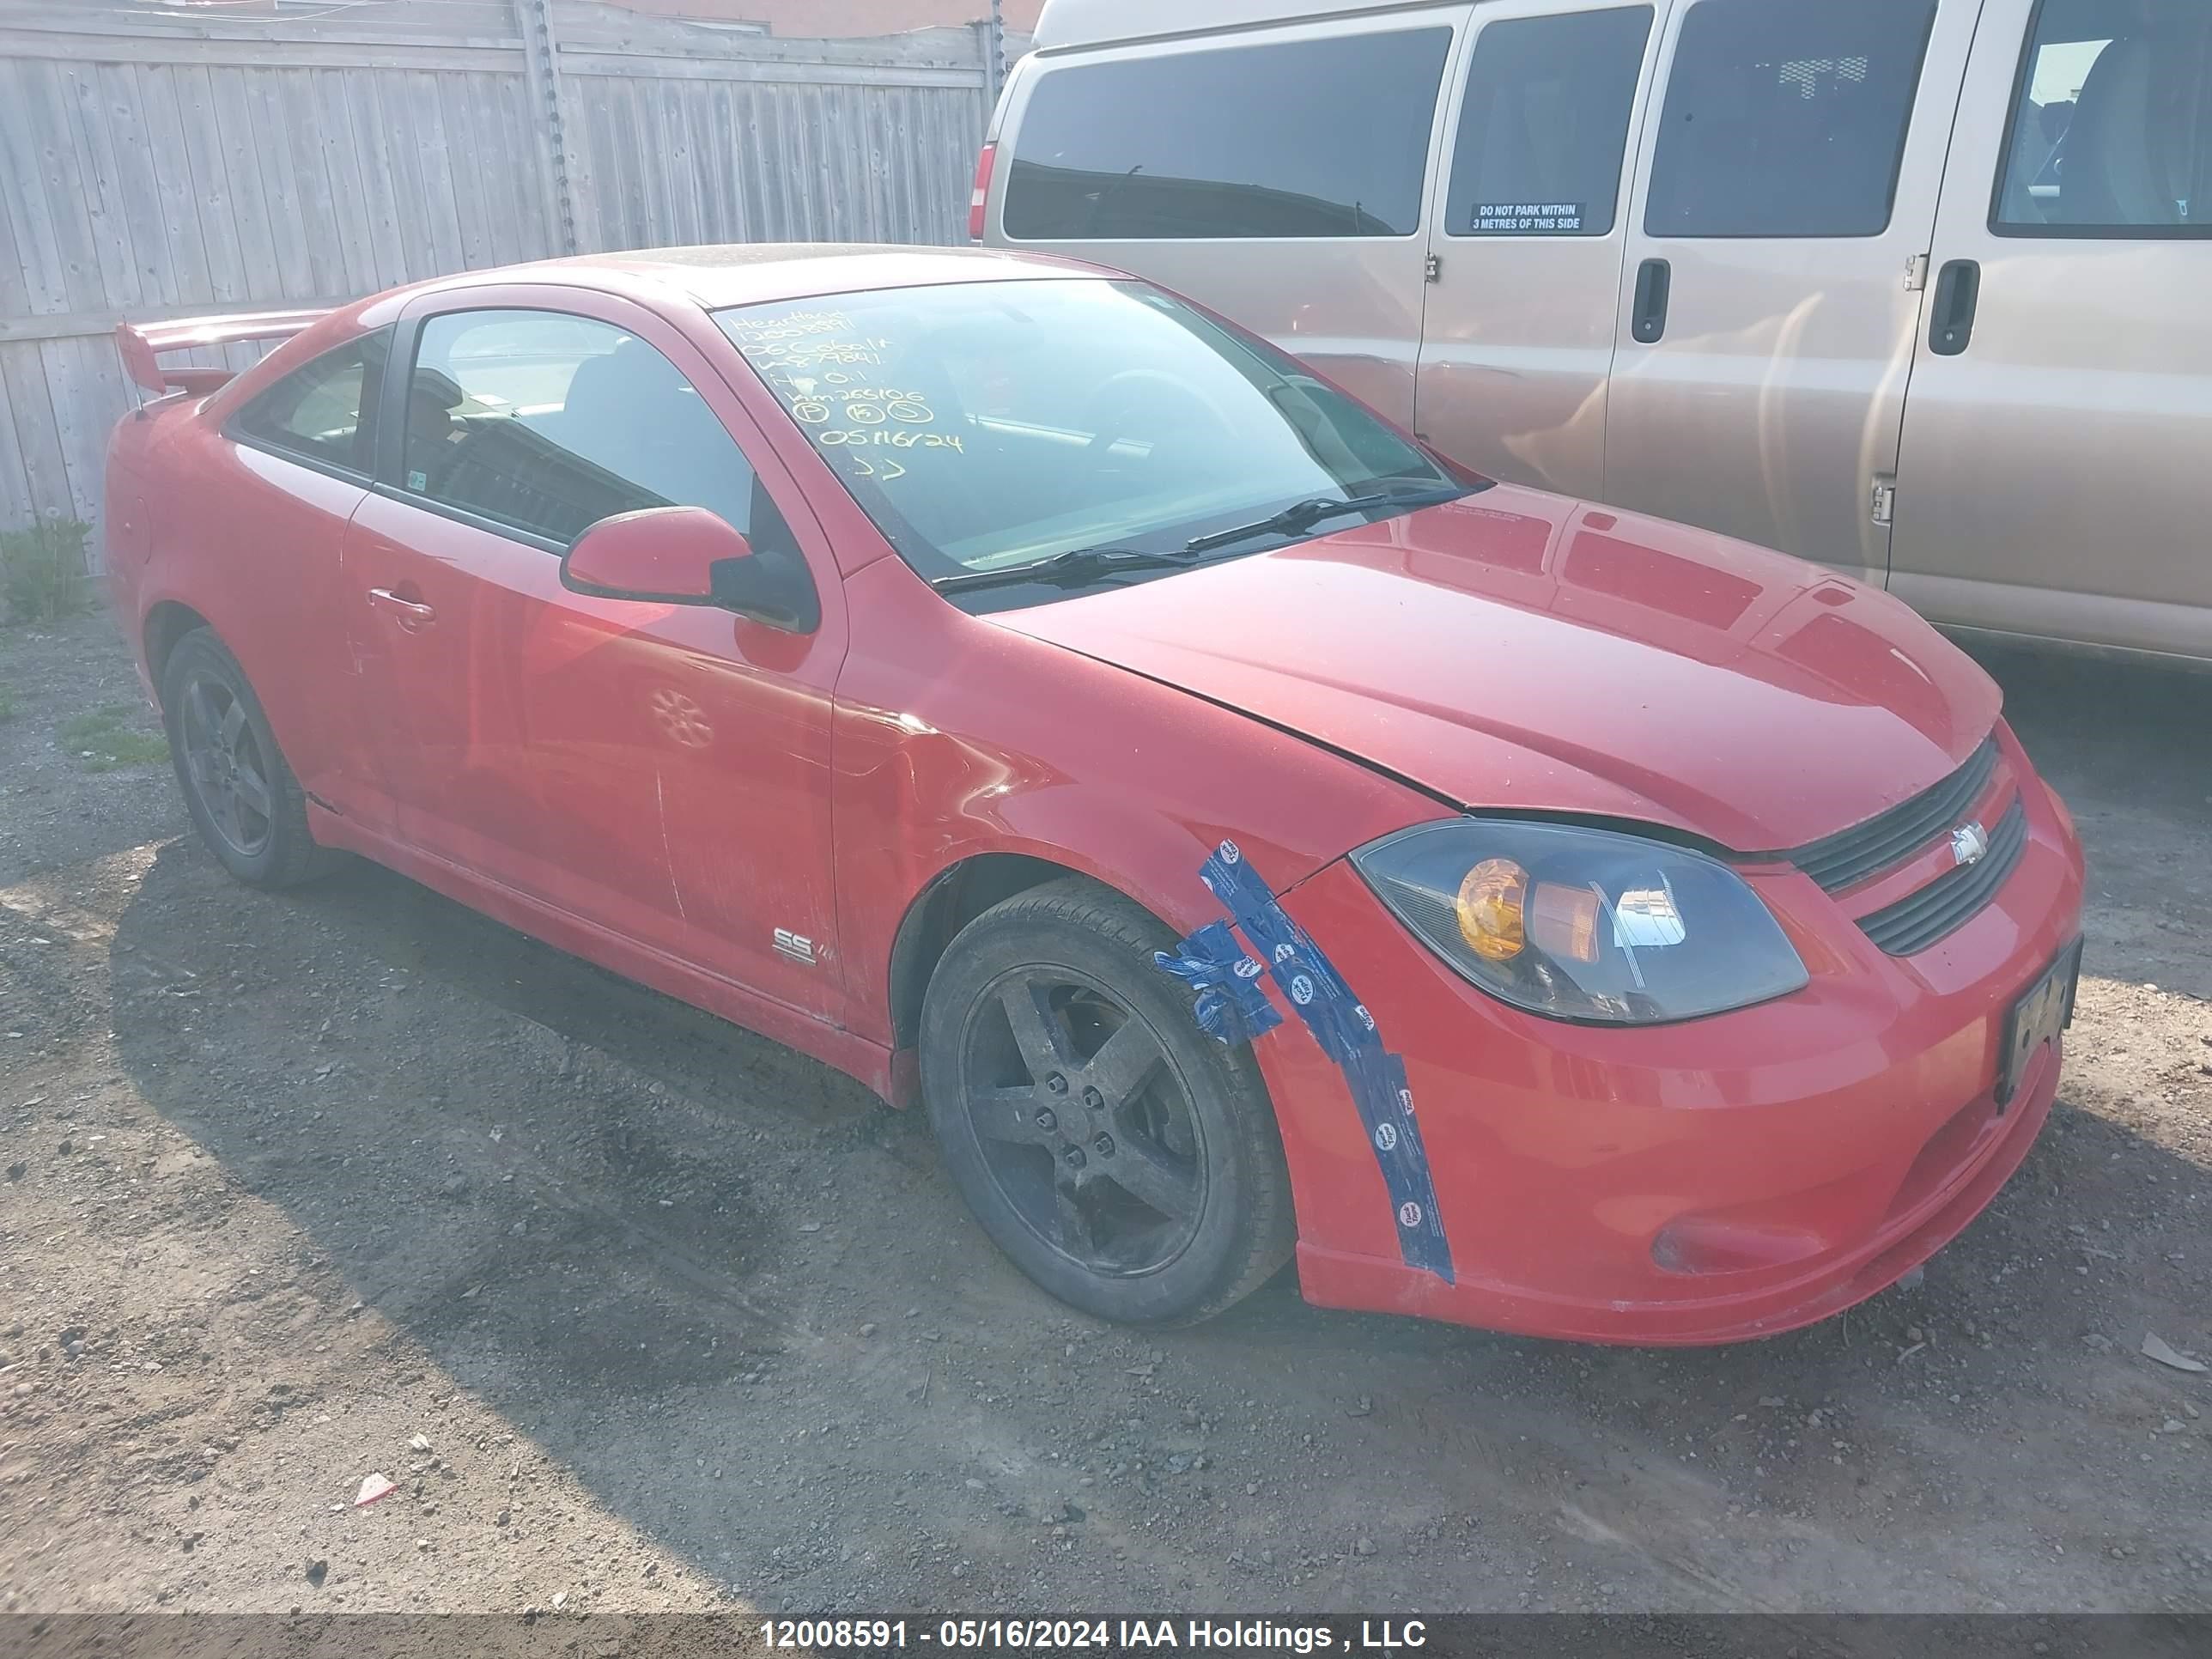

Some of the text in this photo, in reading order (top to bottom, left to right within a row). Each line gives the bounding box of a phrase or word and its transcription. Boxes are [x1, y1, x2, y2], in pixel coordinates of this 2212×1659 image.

[1480, 204, 1576, 216] DO NOT PARK WITHIN
[1473, 218, 1580, 229] 3 METRES OF THIS SIDE
[774, 927, 812, 956] SS
[1292, 981, 1308, 1003] Tuck
[1297, 978, 1312, 996] Tape
